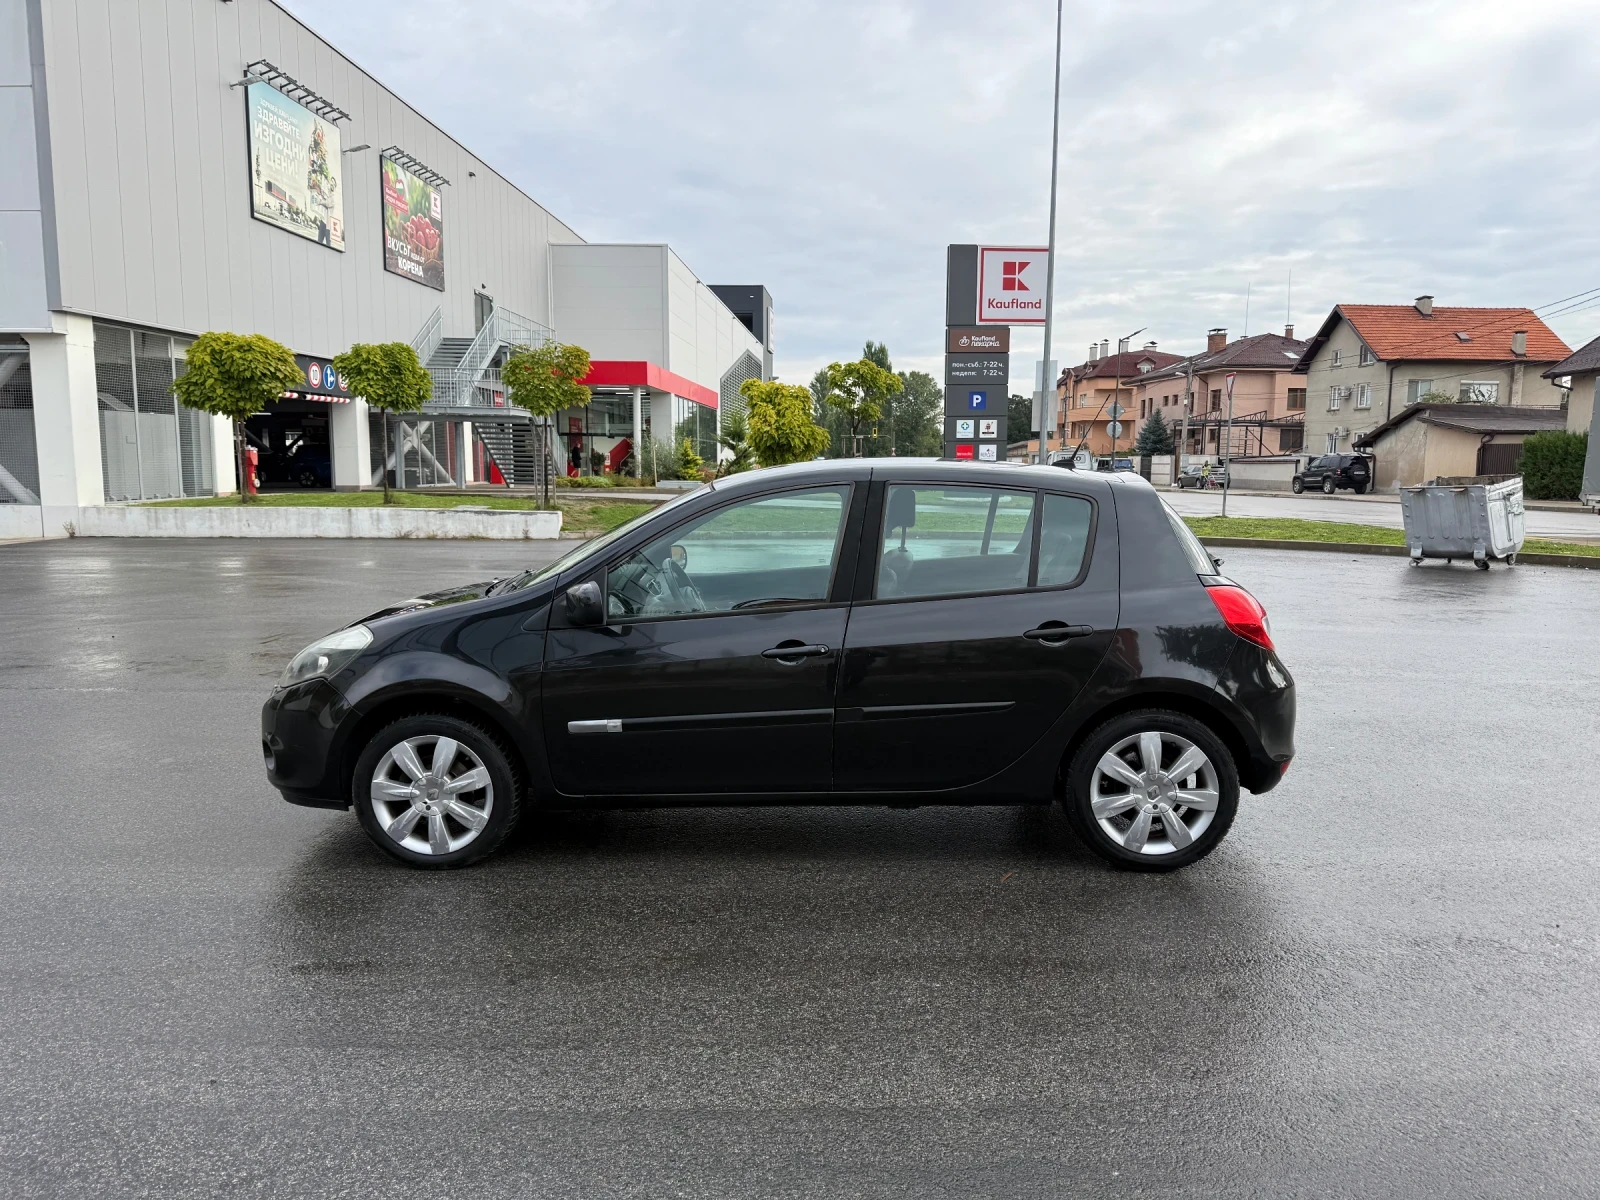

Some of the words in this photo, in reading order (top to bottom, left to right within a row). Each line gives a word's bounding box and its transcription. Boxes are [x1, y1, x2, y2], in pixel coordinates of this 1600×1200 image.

[257, 105, 300, 139] ЗДРАВЕЙТЕ
[254, 119, 307, 162] ИЗГОДНИ
[265, 147, 299, 178] ЦЕНИ!
[387, 235, 411, 256] ВКУСЪТ
[397, 255, 424, 278] КОРЕНА
[987, 297, 1042, 309] Kaufland
[973, 394, 982, 407] P
